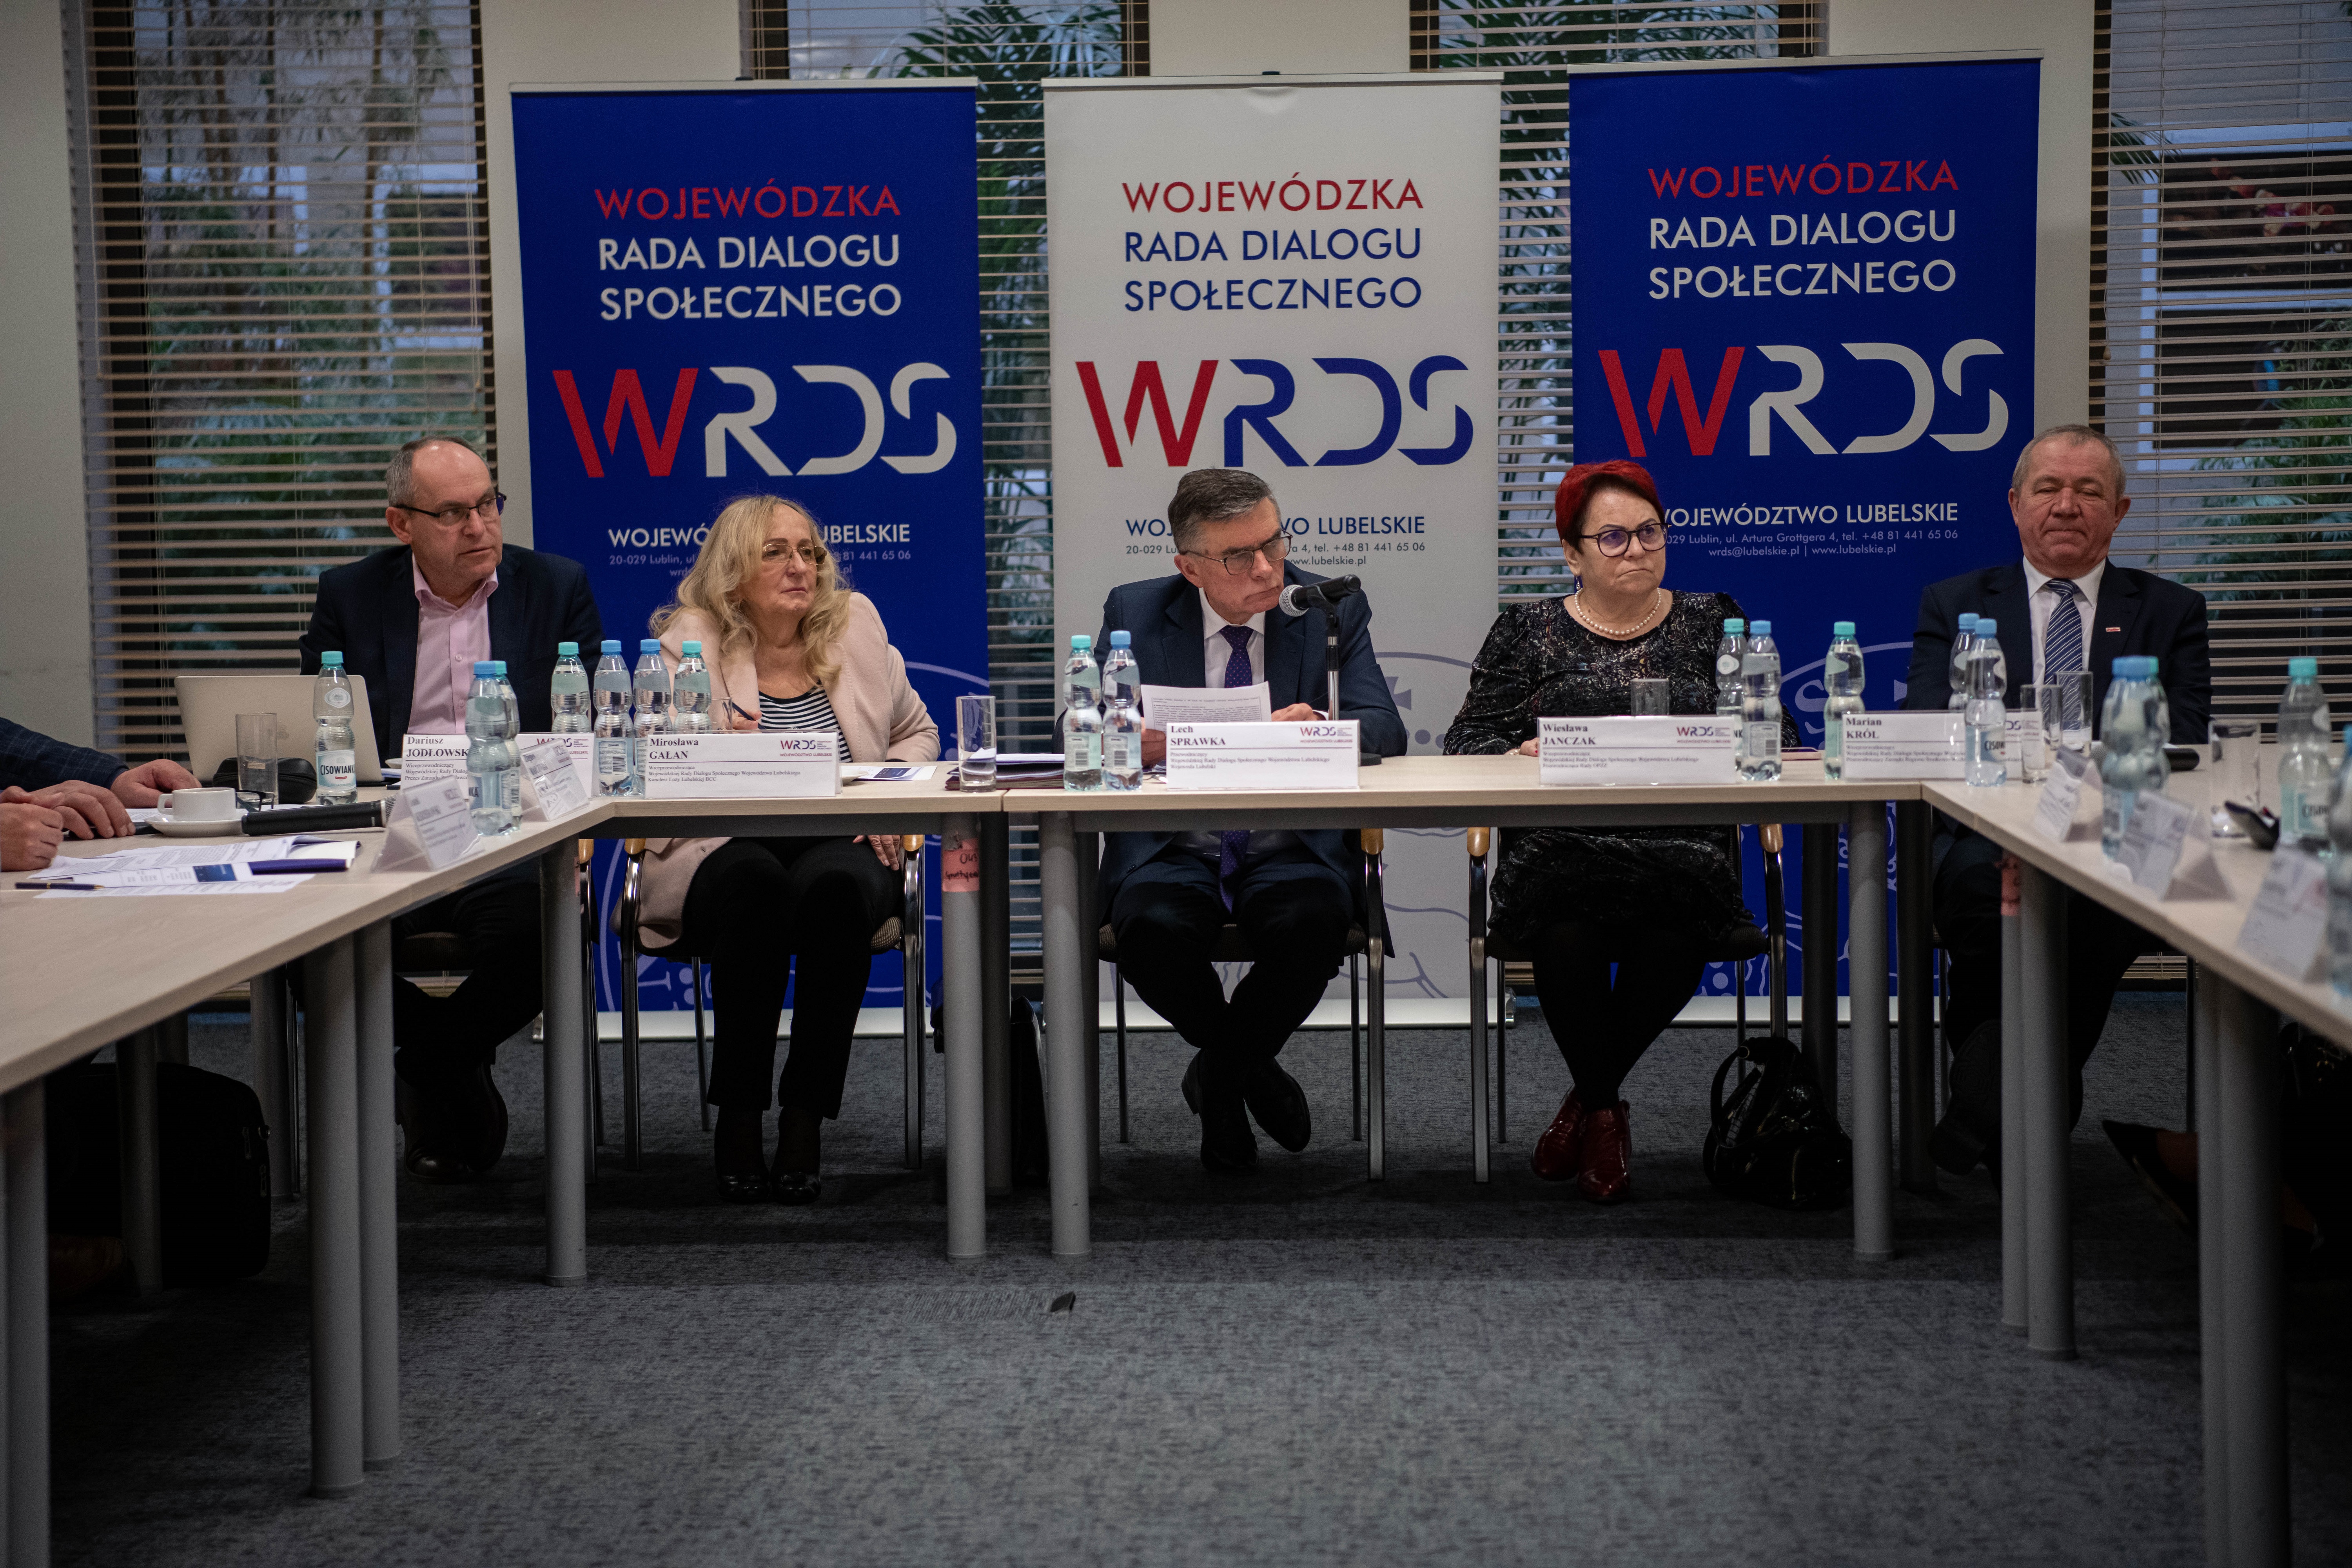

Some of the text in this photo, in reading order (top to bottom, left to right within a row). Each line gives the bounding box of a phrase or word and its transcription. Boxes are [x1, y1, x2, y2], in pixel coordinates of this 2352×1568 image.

[1648, 155, 1958, 199] WOJEWÓDZKA
[595, 178, 900, 220] WOJEWÓDZKA
[1122, 172, 1423, 213] WOJEWÓDZKA
[1651, 210, 1955, 249] RADA DIALOGU
[599, 234, 899, 270] RADA DIALOGU
[1126, 228, 1420, 262] RADA DIALOGU
[1649, 260, 1955, 299] SPOŁECZNEGO
[601, 284, 901, 320] SPOŁECZNEGO
[1125, 277, 1421, 311] SPOŁECZNEGO
[1598, 339, 2008, 457] WRDS
[553, 362, 956, 477] WRDS
[1075, 355, 1473, 467] WRDS
[1847, 503, 1957, 523] LUBELSKIE
[1319, 516, 1424, 534] LUBELSKIE
[608, 523, 910, 548] WOJEWÓ UBELSKIE
[1667, 535, 1685, 544] 029
[1690, 534, 1722, 544] Lublin,
[1726, 534, 1737, 543] ul.
[1777, 533, 1825, 543] Grottgera
[1829, 532, 1838, 542] 4,
[1842, 532, 1857, 541] tel.
[1863, 531, 1884, 540] +48
[1887, 531, 1898, 539] 81
[1904, 530, 1922, 539] 441
[1928, 530, 1941, 539] 65
[1945, 530, 1958, 539] 06
[843, 552, 854, 560] 81
[859, 551, 877, 560] 441
[882, 551, 895, 560] 65
[898, 550, 911, 559] 06
[1126, 545, 1162, 554] 20-029
[1301, 544, 1310, 553] 4,
[1314, 543, 1328, 552] tel.
[1334, 543, 1354, 552] +48
[1358, 543, 1368, 552] 81
[1397, 543, 1408, 551] 65
[1413, 543, 1425, 551] 06
[1709, 546, 1799, 557] wrds@lubelskie.pl
[1812, 544, 1896, 555] www.lubelskie.pl
[610, 554, 695, 564] 20-029 Lublin, ul
[1290, 555, 1367, 567] ww.lubelskie.pl
[1300, 727, 1336, 736] WRDS
[1677, 727, 1713, 736] WRDS
[1847, 728, 1878, 739] KRÓL
[407, 748, 469, 757] JODŁOWSK
[780, 740, 816, 750] WRDS
